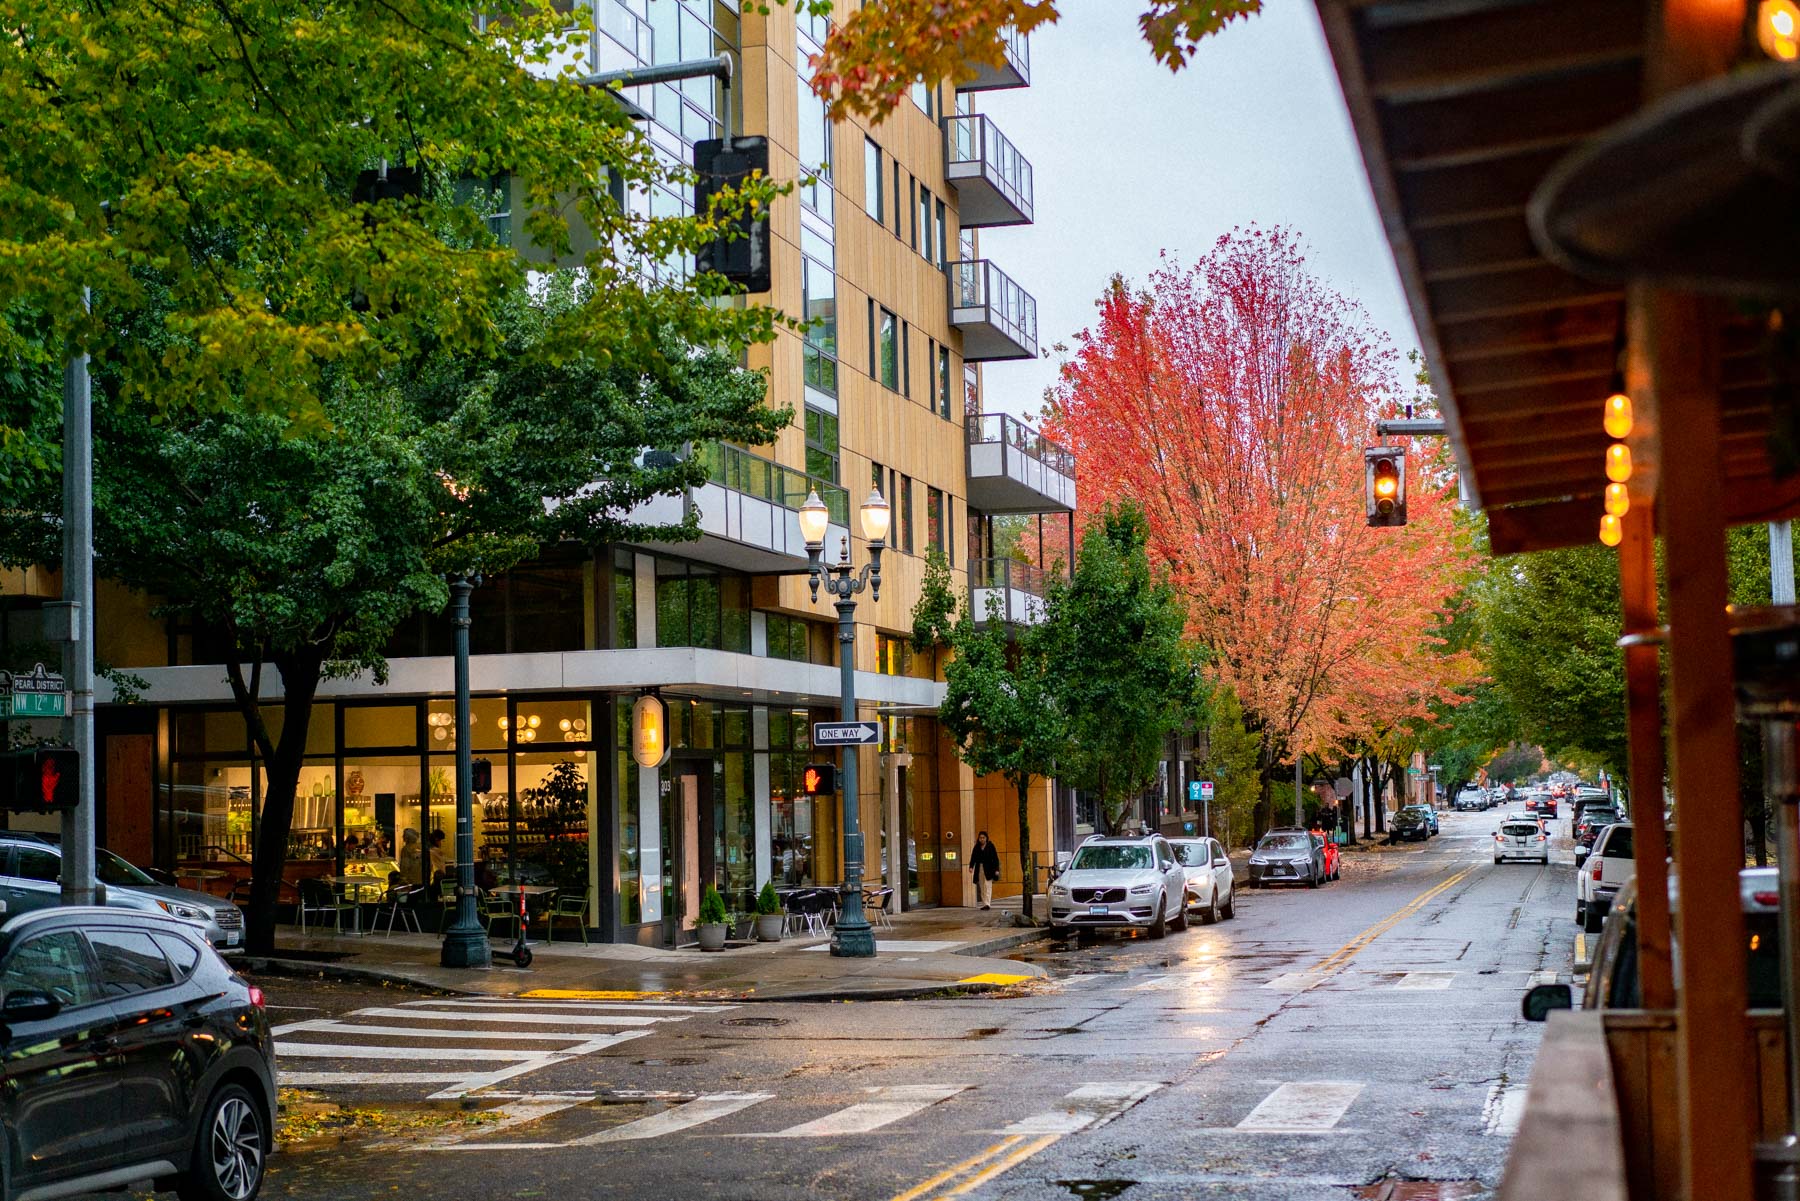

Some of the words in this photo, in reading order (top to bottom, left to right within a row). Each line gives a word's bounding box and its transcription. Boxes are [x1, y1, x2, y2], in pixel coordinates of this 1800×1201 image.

[15, 680, 35, 689] PEARL
[36, 680, 64, 690] DISTRICT
[15, 694, 27, 711] NW
[53, 695, 62, 711] AV
[821, 729, 839, 738] ONE
[841, 728, 860, 738] WAY
[661, 780, 671, 791] 303
